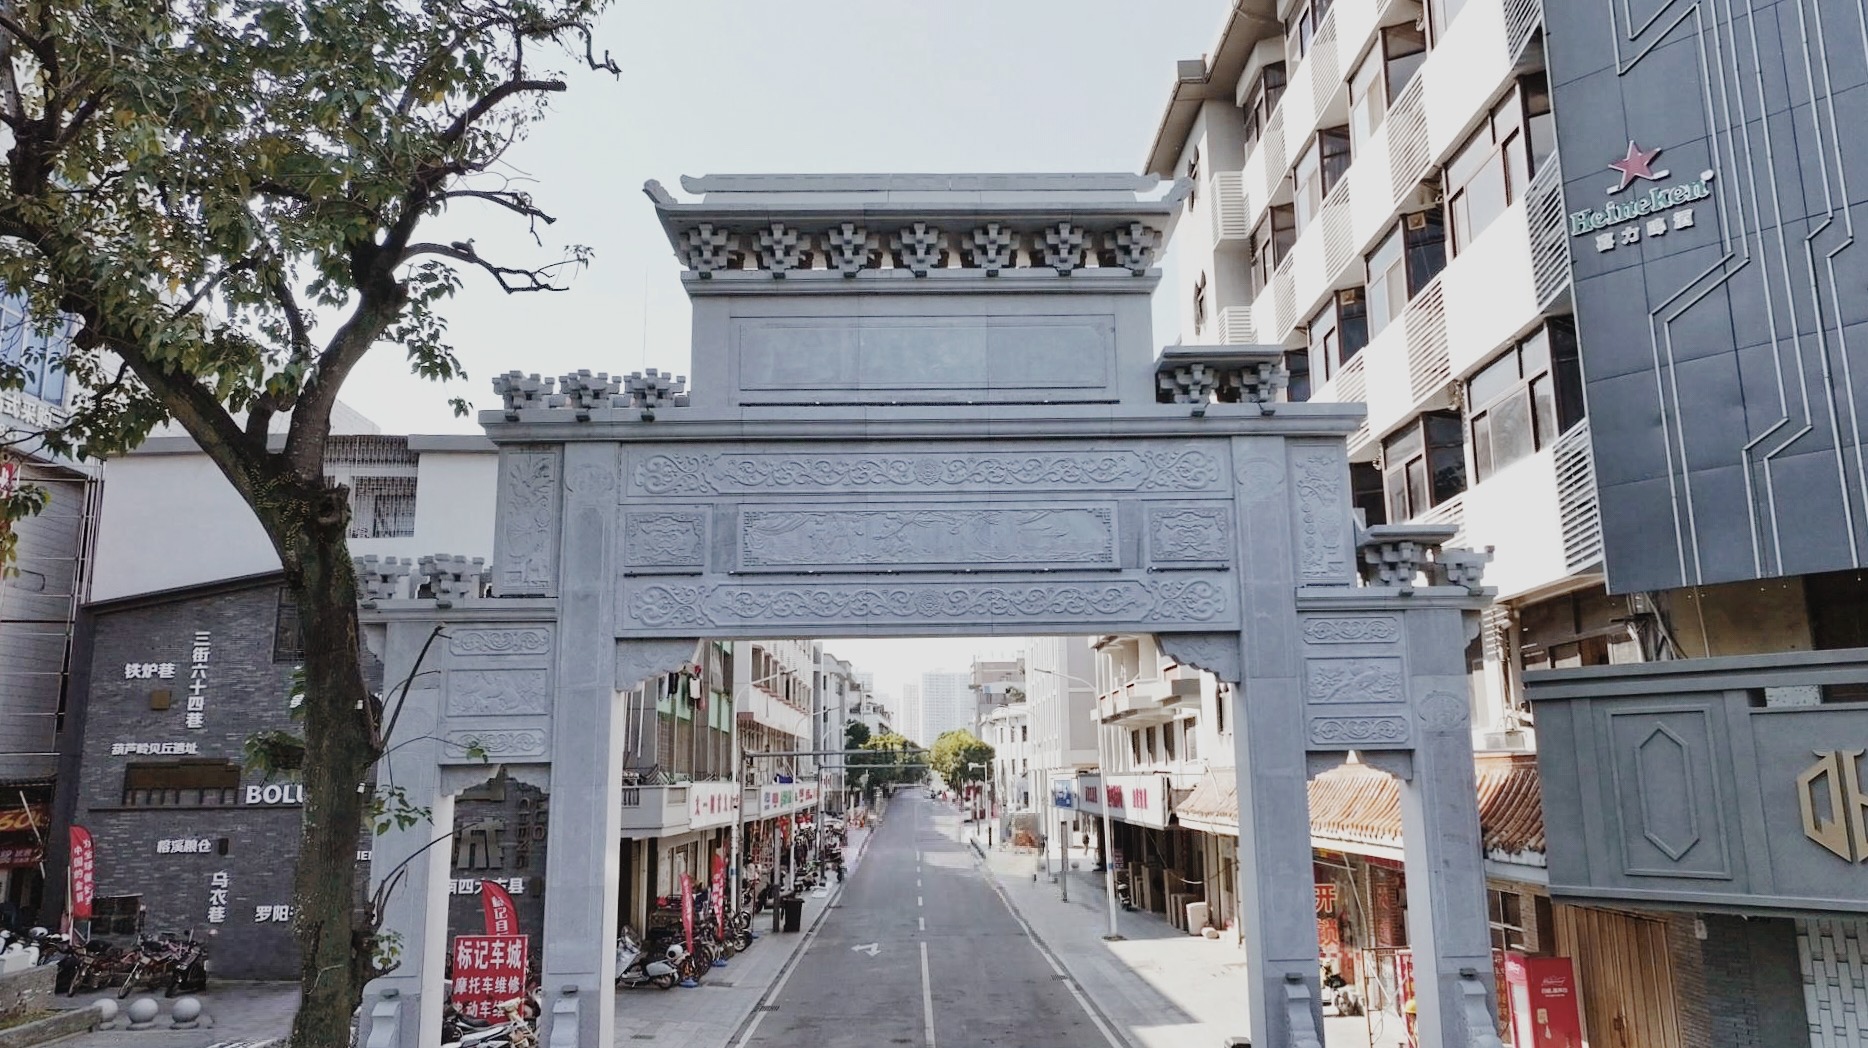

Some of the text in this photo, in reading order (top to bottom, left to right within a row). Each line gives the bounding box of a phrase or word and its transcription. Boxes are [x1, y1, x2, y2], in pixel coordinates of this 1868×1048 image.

[1569, 179, 1711, 236] Heineken
[124, 662, 177, 680] 铁炉巷
[185, 630, 212, 729] 三街六十四巷
[207, 869, 230, 924] 乌衣巷
[255, 905, 294, 923] 罗阳
[1314, 883, 1340, 945] 开锁
[457, 938, 523, 970] 标记车城
[454, 976, 521, 995] 摩托车维修
